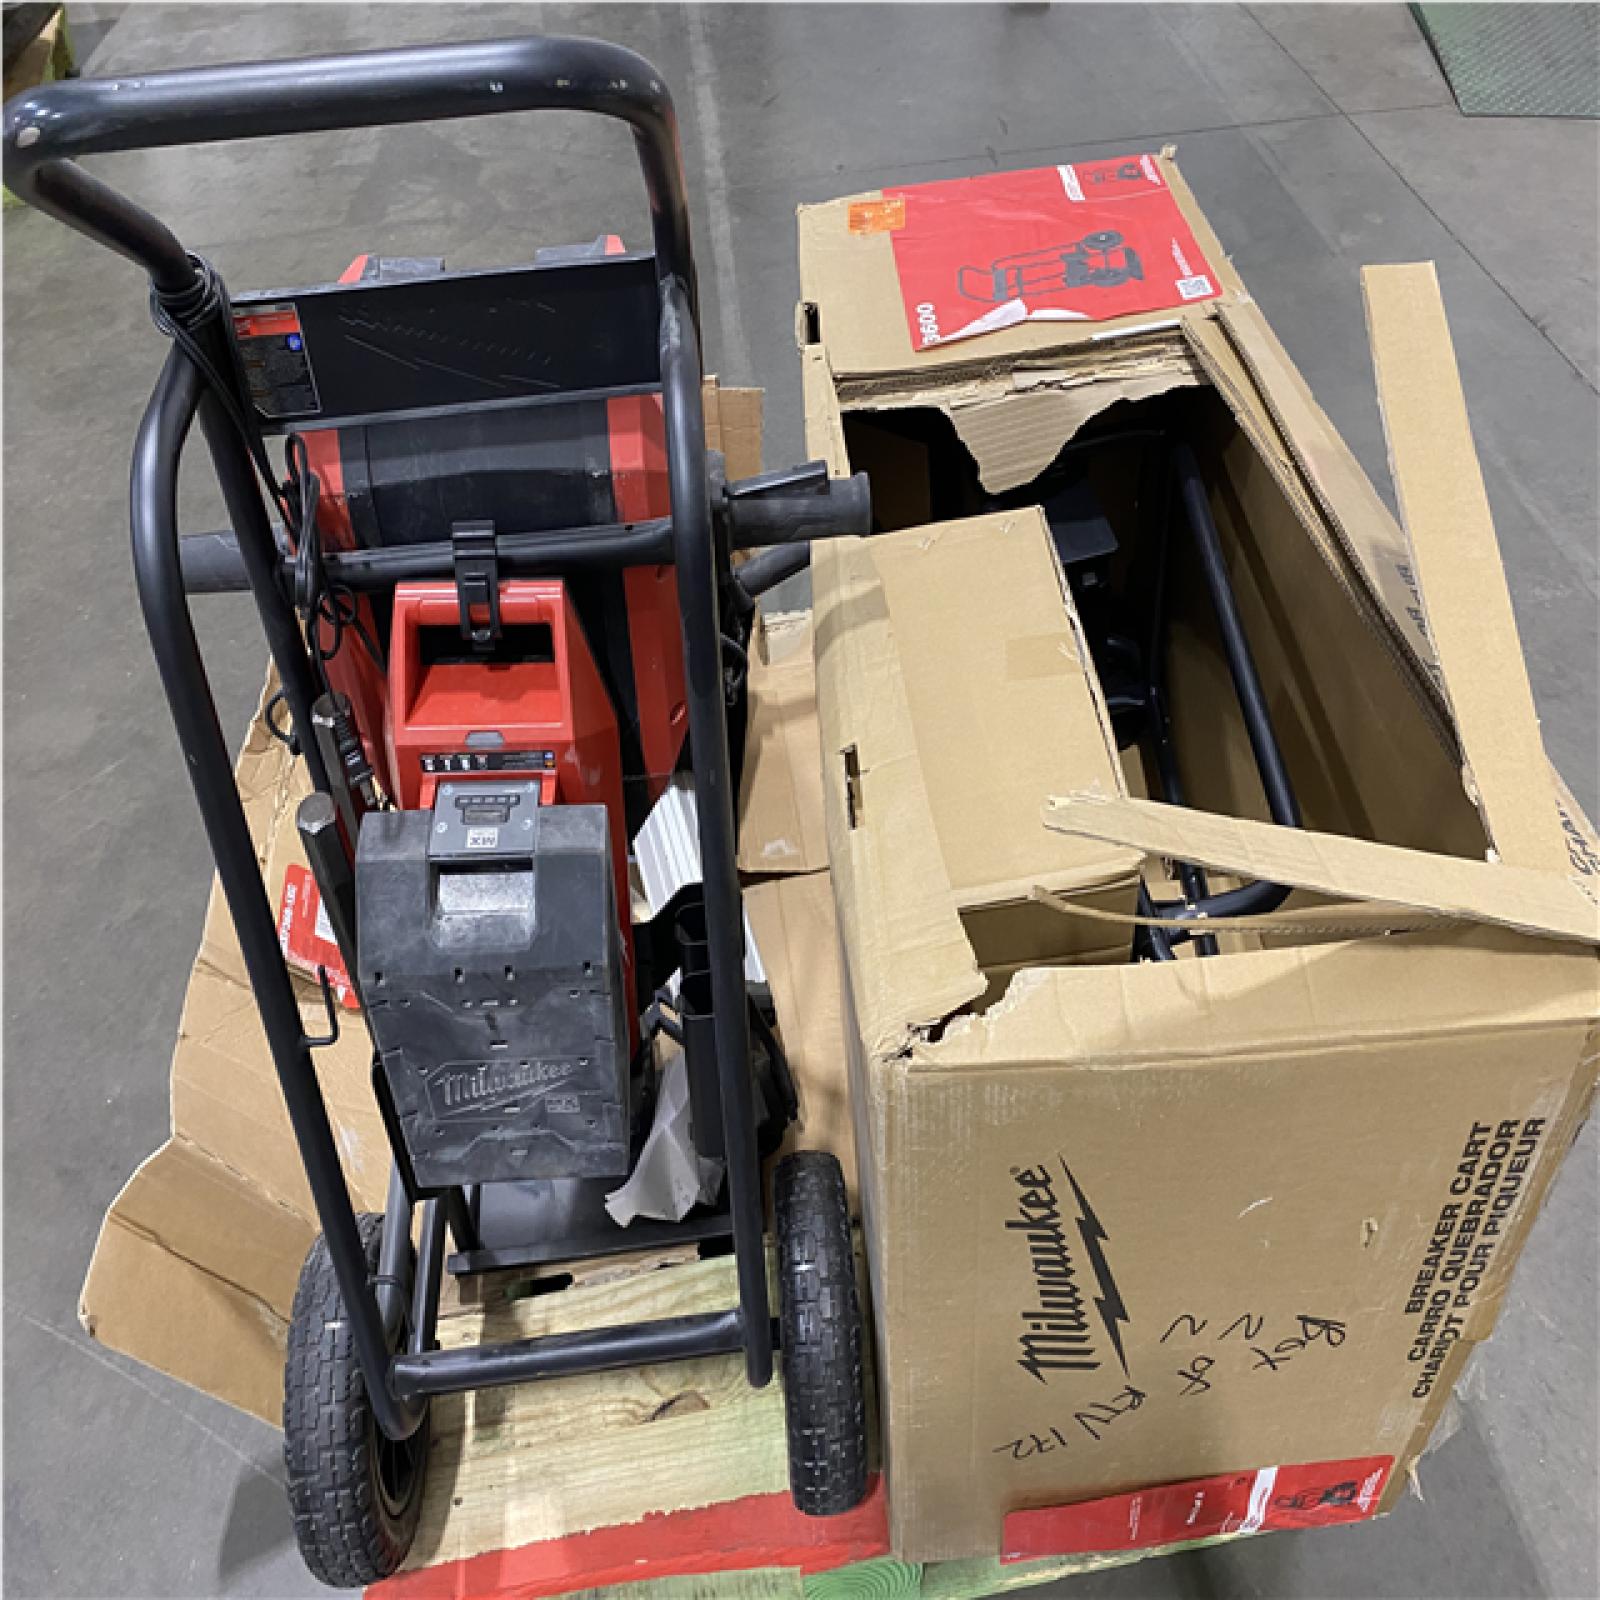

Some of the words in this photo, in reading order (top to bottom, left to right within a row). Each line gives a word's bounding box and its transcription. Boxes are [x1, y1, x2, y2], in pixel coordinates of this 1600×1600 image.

[433, 1061, 574, 1106] Milwaukee
[1005, 1163, 1102, 1385] Milwaukee
[1405, 1202, 1462, 1315] BREAKER
[1450, 1121, 1493, 1196] CART
[1407, 1289, 1451, 1362] CARRO
[1440, 1119, 1520, 1283] QUEBRADOR
[1412, 1312, 1465, 1399] CHARIOT
[1452, 1242, 1495, 1308] POUR
[1482, 1117, 1546, 1236] PIQUEUR
[1250, 1314, 1346, 1371] Box
